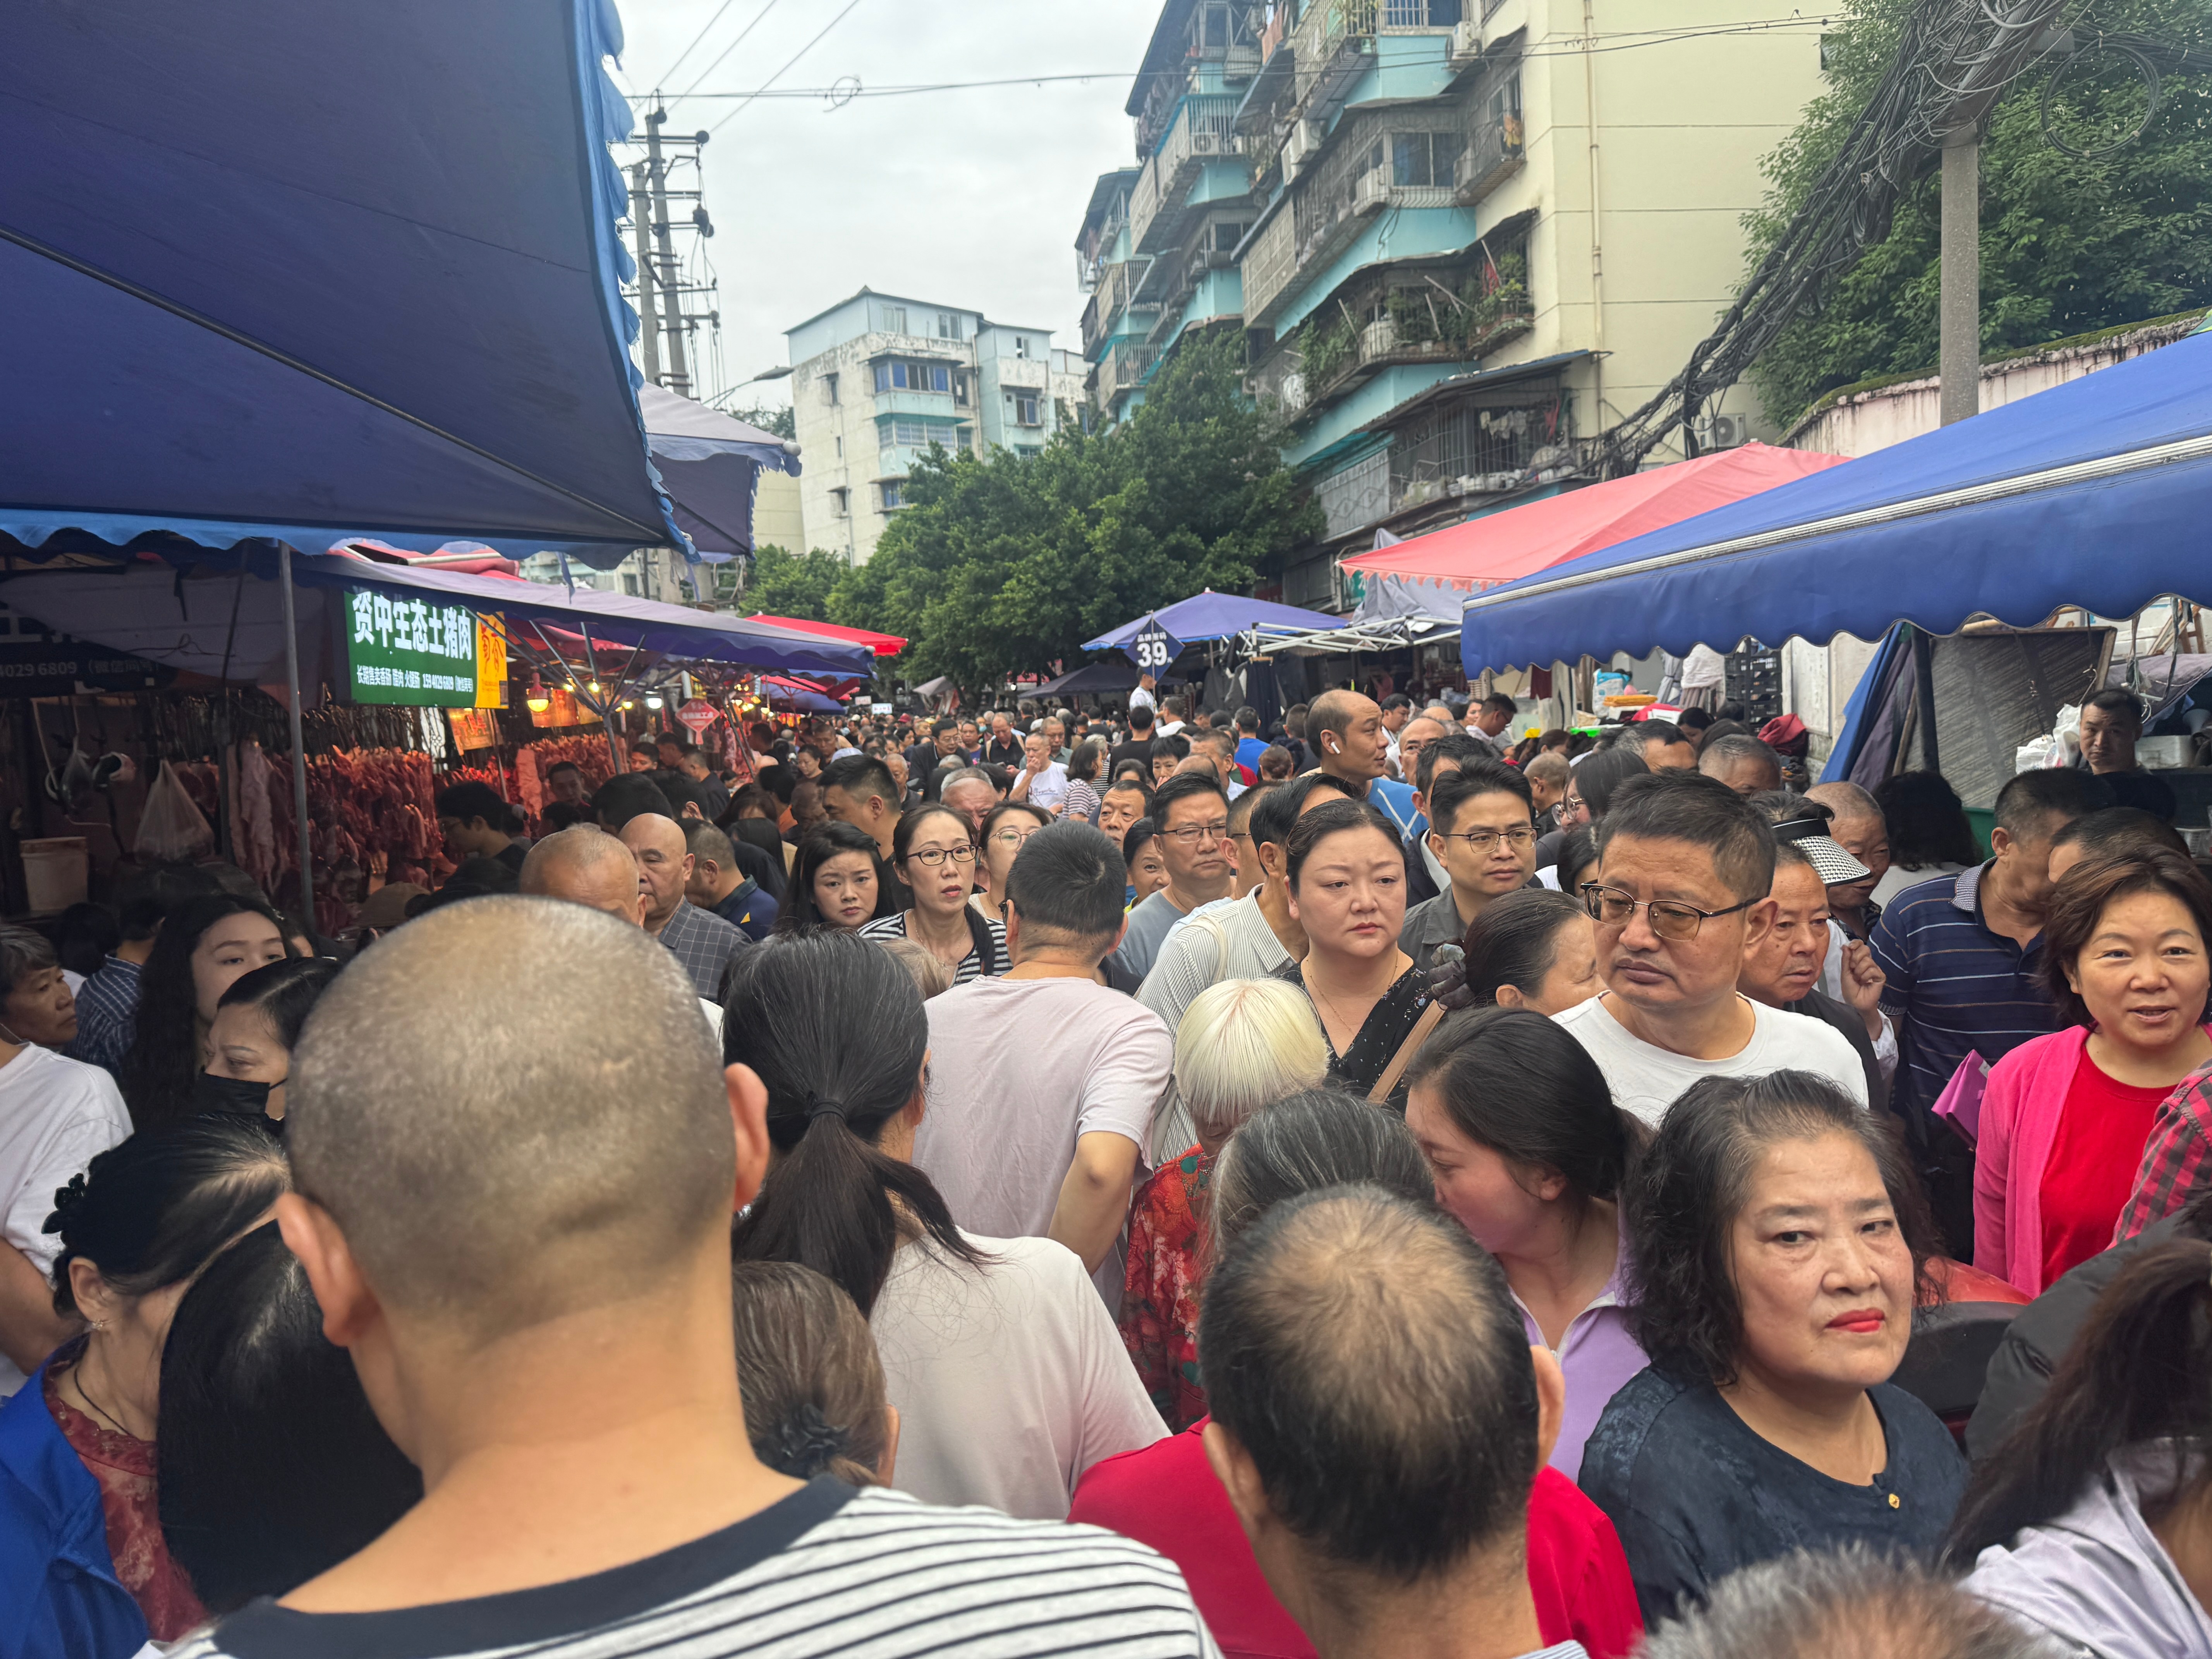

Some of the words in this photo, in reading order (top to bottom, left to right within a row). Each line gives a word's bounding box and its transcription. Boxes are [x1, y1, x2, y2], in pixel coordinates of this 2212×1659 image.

[352, 590, 472, 661] 资中生态土猪肉
[38, 661, 77, 676] 6809
